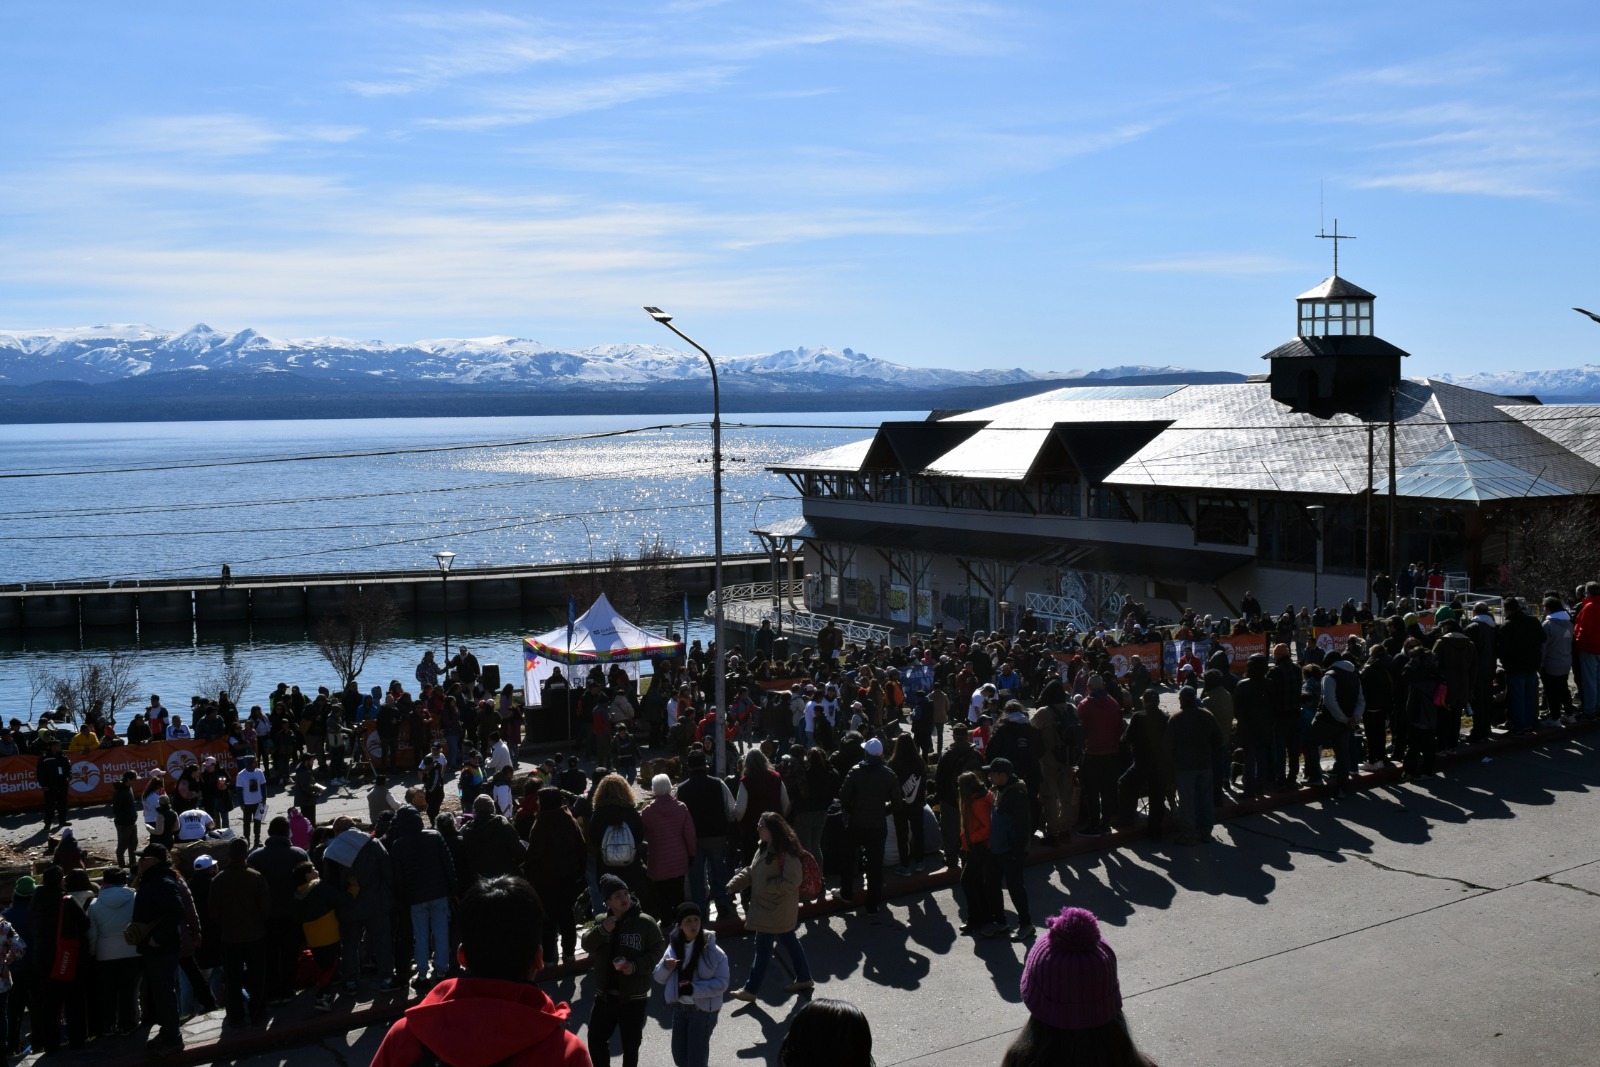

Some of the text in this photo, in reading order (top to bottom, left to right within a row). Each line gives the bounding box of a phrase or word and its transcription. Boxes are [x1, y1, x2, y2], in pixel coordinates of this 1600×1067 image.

[1235, 643, 1265, 653] Municipio
[102, 759, 158, 773] Municipio
[0, 769, 36, 782] Munic
[902, 773, 917, 796] NIKE
